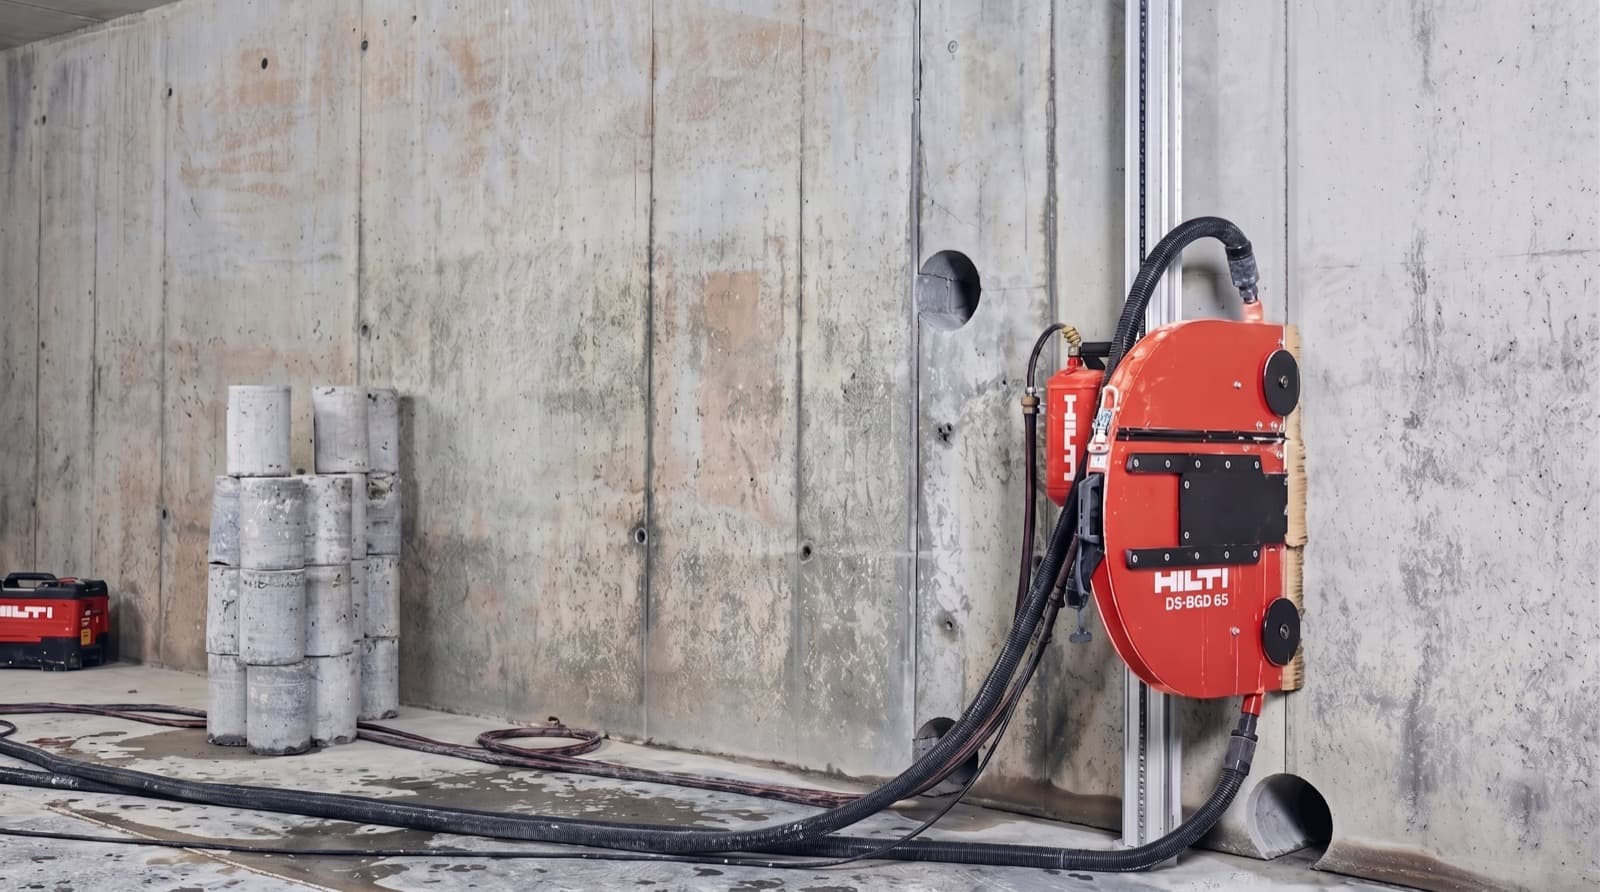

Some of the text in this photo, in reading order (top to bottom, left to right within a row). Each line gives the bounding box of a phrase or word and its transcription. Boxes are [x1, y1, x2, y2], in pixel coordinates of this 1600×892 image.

[1063, 394, 1077, 482] HILTI
[1154, 567, 1229, 594] HILTI
[1165, 593, 1229, 611] DS-BGD 65
